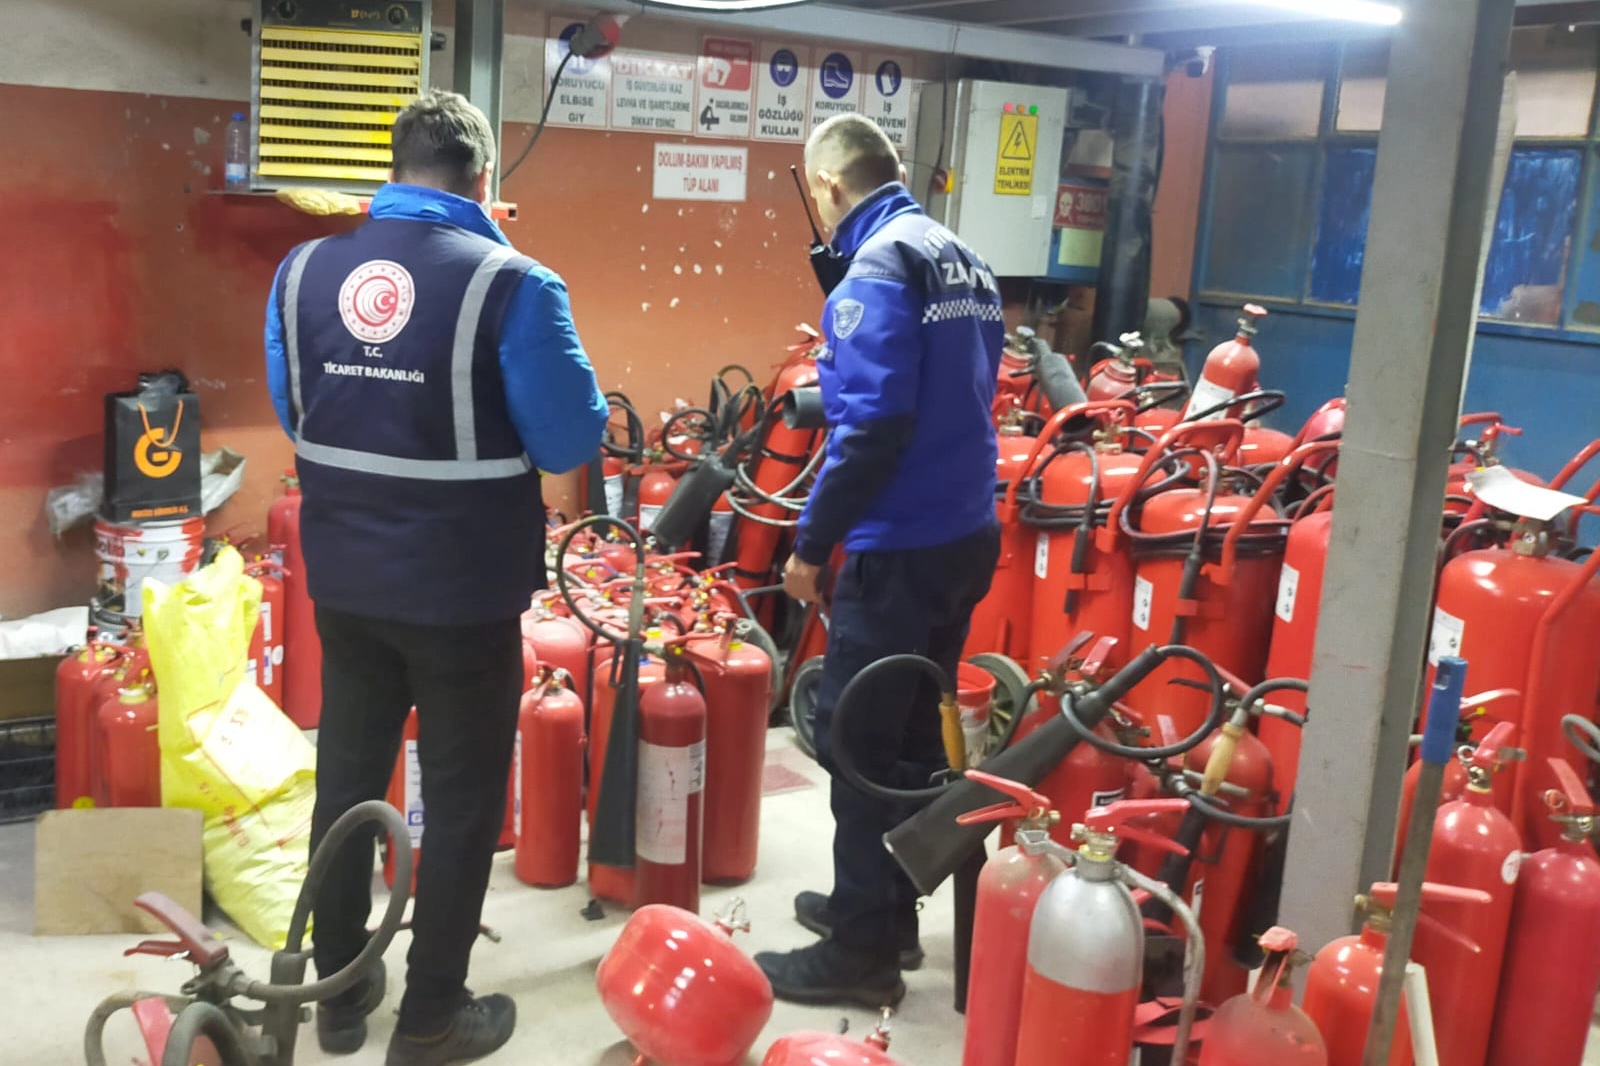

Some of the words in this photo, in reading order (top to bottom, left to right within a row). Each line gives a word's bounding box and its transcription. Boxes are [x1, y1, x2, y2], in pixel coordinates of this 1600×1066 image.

[777, 93, 787, 107] İŞ
[815, 101, 856, 112] KORUYUCU
[883, 100, 892, 114] İŞ
[759, 107, 804, 121] GÖZLÜĞÜ
[760, 125, 800, 137] KULLAN
[363, 346, 384, 359] T.C.
[323, 361, 364, 377] TİCARET
[364, 366, 425, 384] BAKANLIĞI
